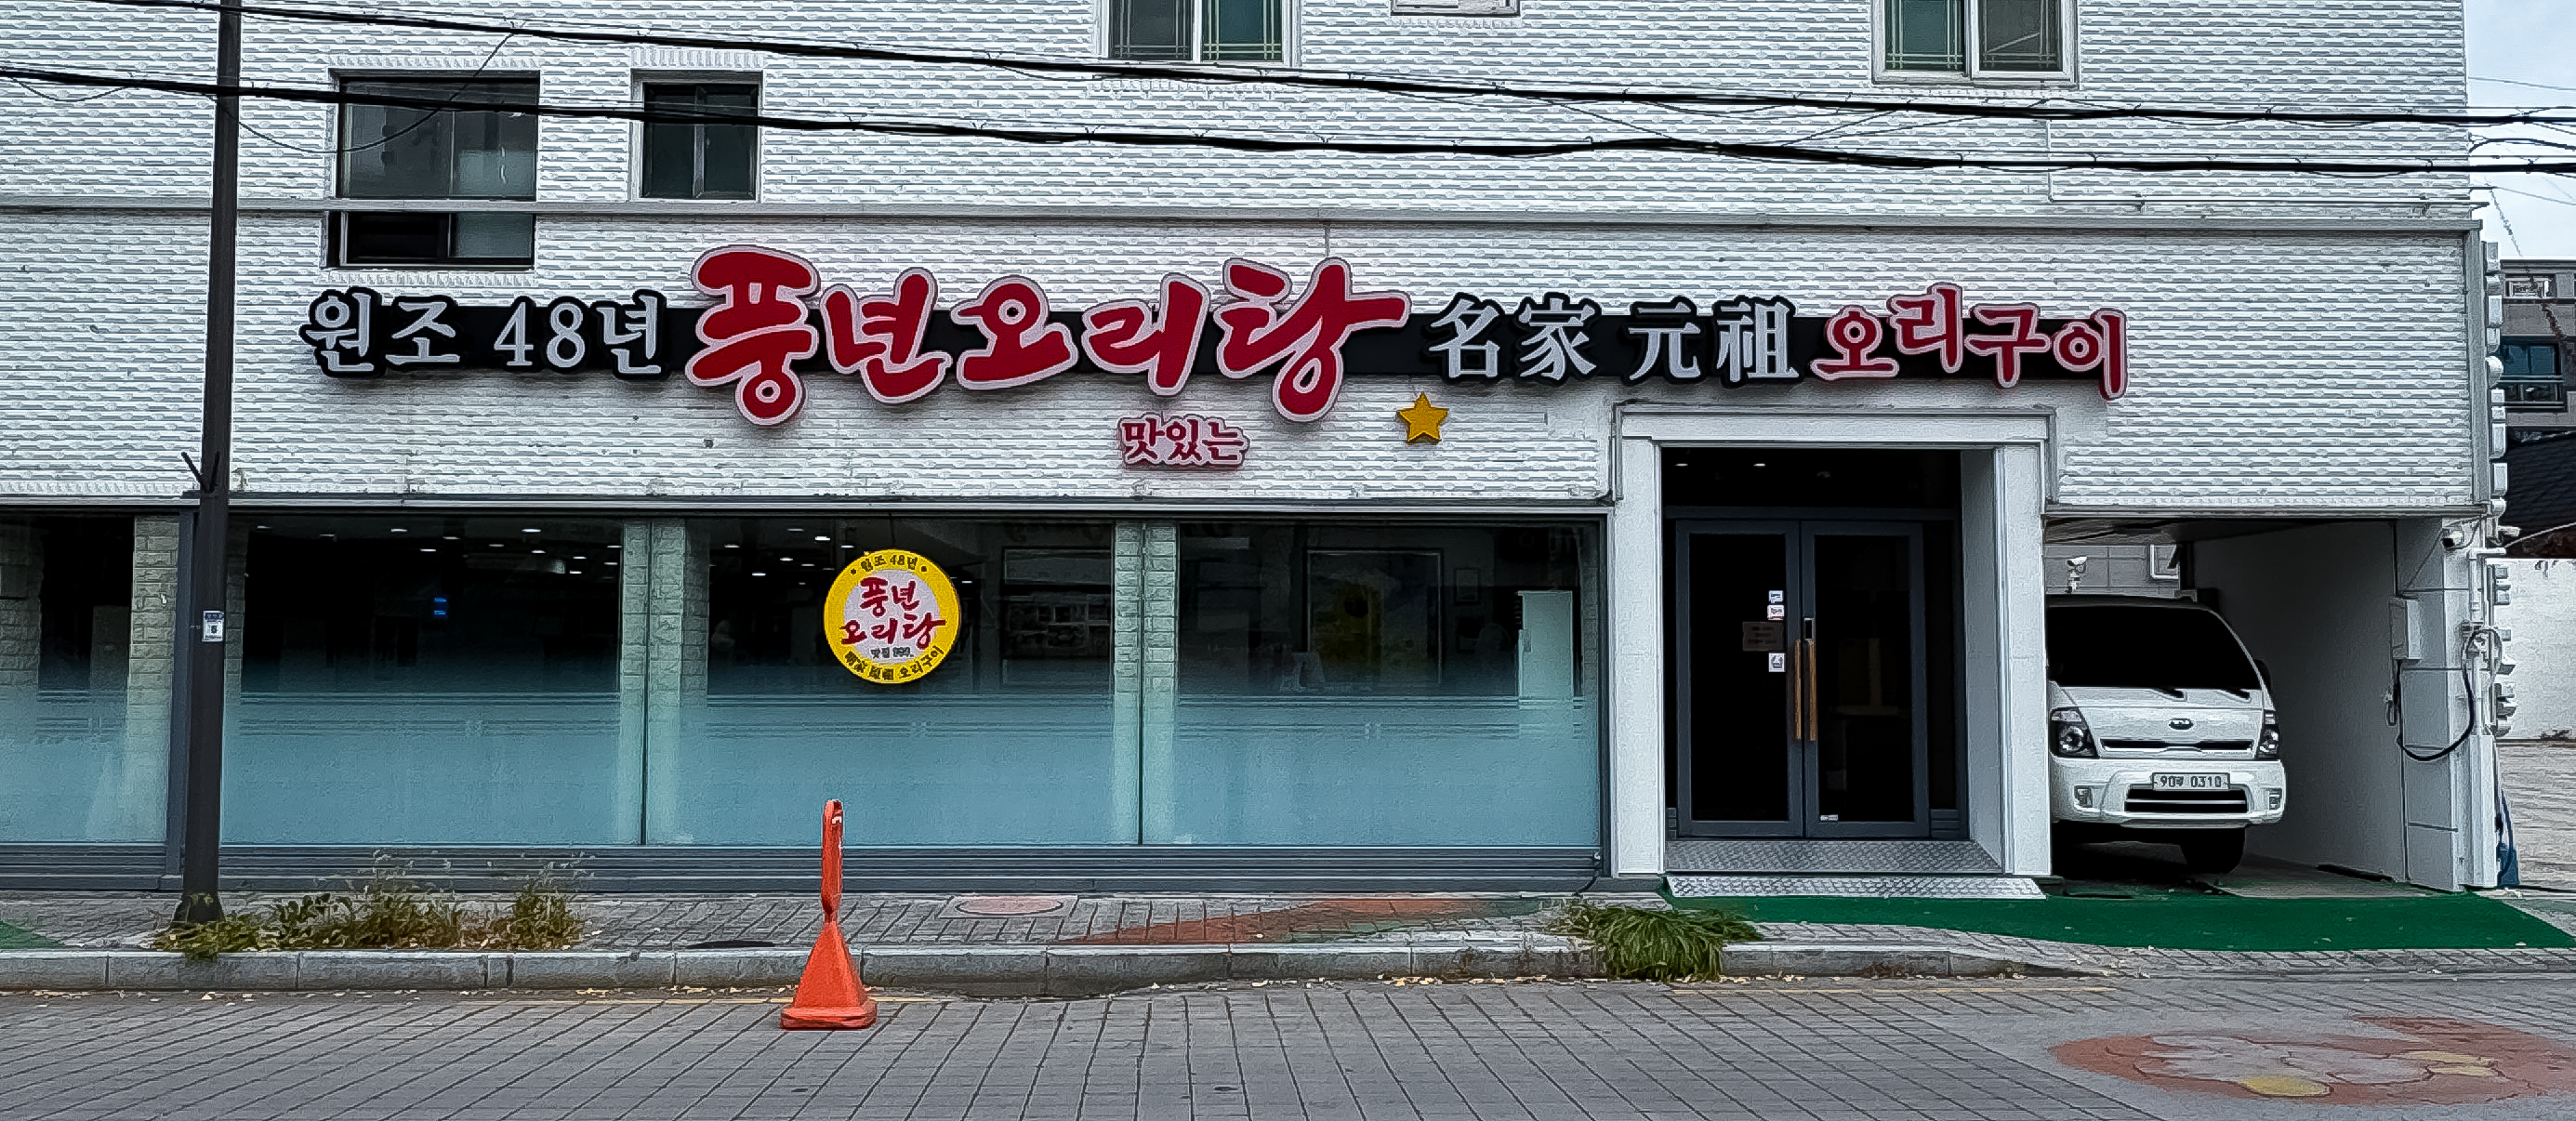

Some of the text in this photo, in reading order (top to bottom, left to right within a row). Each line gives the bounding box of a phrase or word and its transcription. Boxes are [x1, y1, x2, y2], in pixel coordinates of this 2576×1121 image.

[306, 289, 663, 376] 원조 48년
[1810, 282, 2128, 400] 오리구이
[1121, 417, 1245, 462] 맛있는
[859, 576, 920, 617] 풍년
[839, 612, 946, 650] 오리탕
[898, 645, 945, 679] 오리구이
[2190, 775, 2222, 788] 0310
